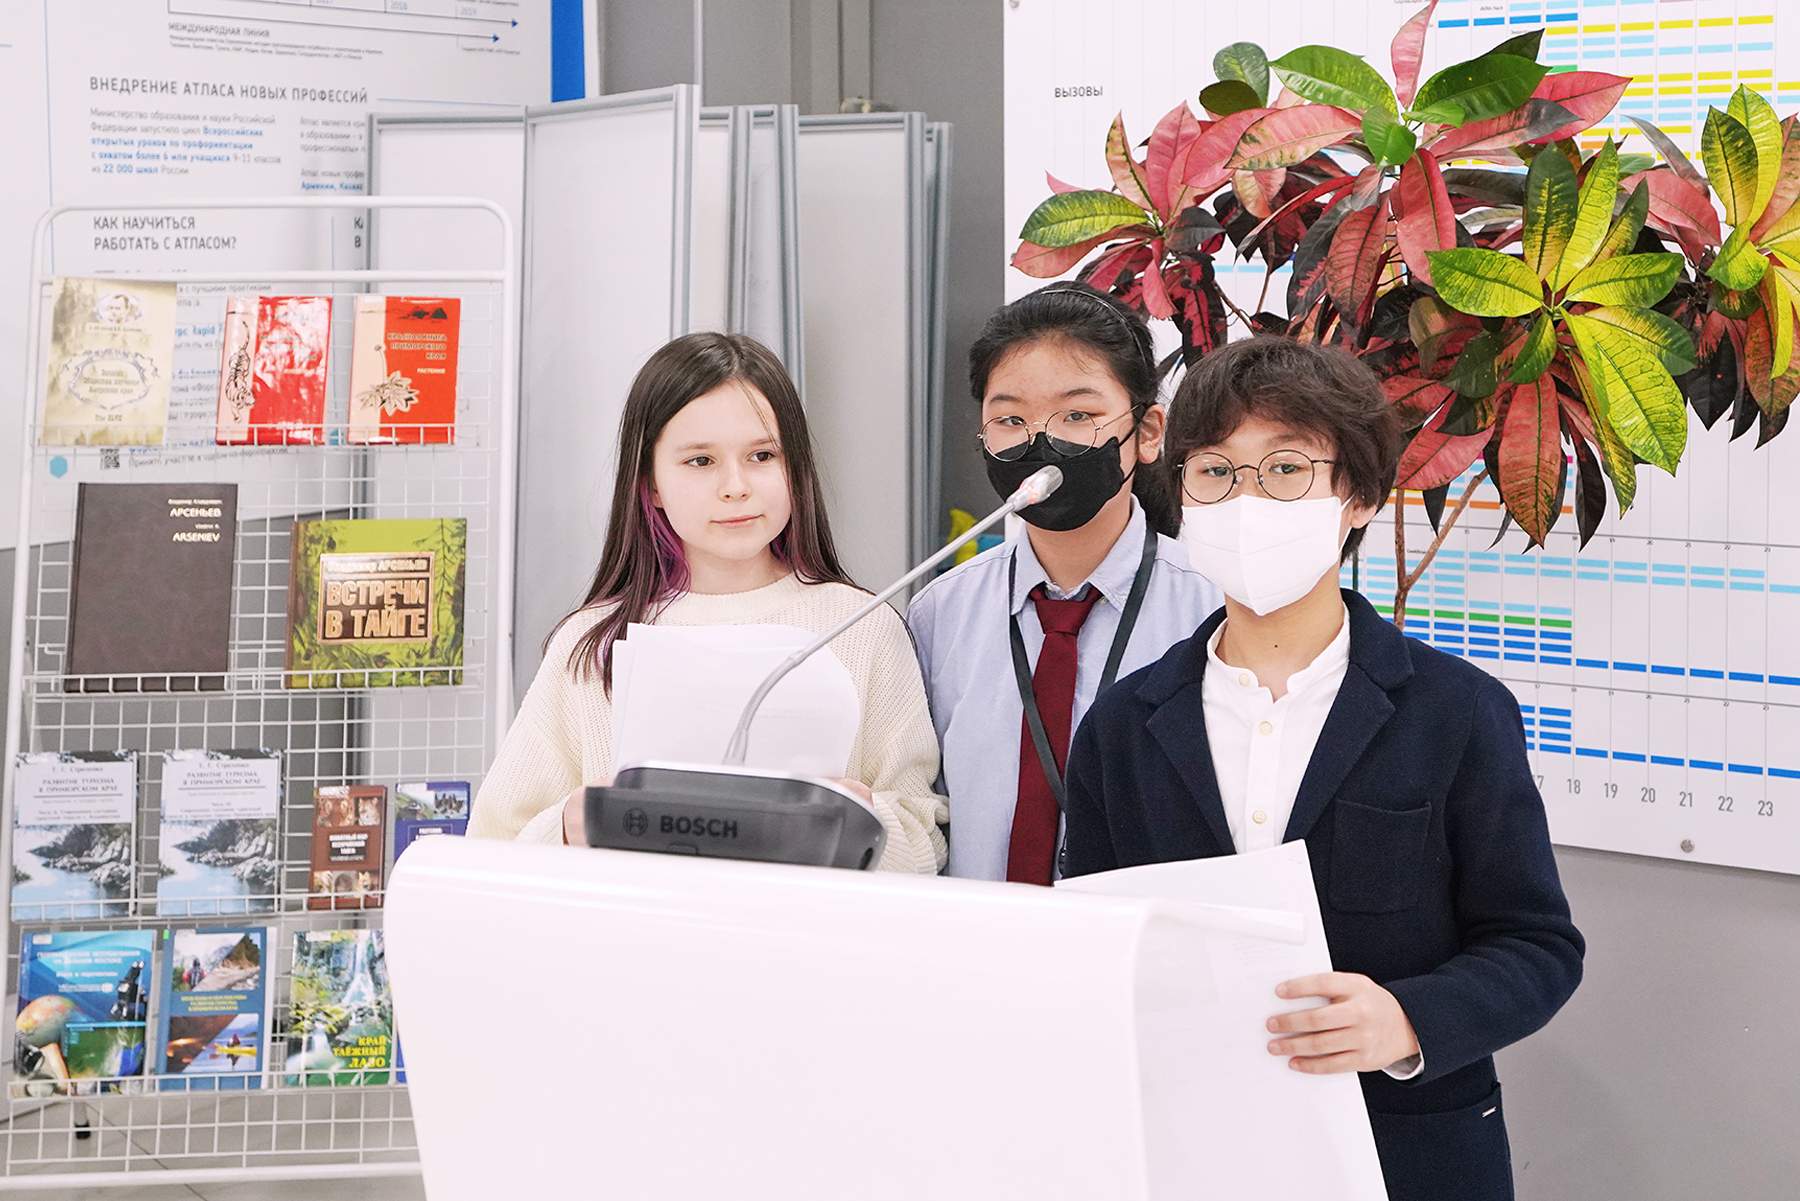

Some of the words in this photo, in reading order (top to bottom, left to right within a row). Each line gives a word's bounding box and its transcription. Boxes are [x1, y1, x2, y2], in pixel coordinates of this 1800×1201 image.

[90, 76, 177, 95] ВНЕДРЕНИЕ
[183, 83, 235, 97] АТЛАСА
[240, 85, 287, 100] НОВЫХ
[292, 87, 368, 103] ПРОФЕССИЙ
[1054, 86, 1103, 98] ВЫЗОВЫ
[103, 164, 114, 174] 22
[93, 216, 119, 230] КАК
[122, 215, 196, 230] НАУЧИТЬСЯ
[94, 236, 159, 251] РАБОТАТЬ
[163, 236, 171, 250] С
[174, 236, 237, 250] АТЛАСОМ?
[354, 235, 362, 249] В
[169, 507, 222, 518] АРСЕНЬЕВ
[172, 532, 220, 542] ARSENIEV
[326, 579, 426, 607] ВСТРЕЧИ
[324, 609, 343, 638] В
[350, 604, 426, 638] ТАЙГЕ
[1533, 775, 1544, 790] 7
[1567, 778, 1581, 795] 18
[1604, 783, 1618, 799] 19
[1640, 787, 1656, 803] 20
[1679, 791, 1693, 808] 21
[1718, 795, 1734, 812] 22
[1757, 800, 1774, 817] 23
[660, 815, 738, 839] BOSCH
[358, 1035, 386, 1046] КРАЙ
